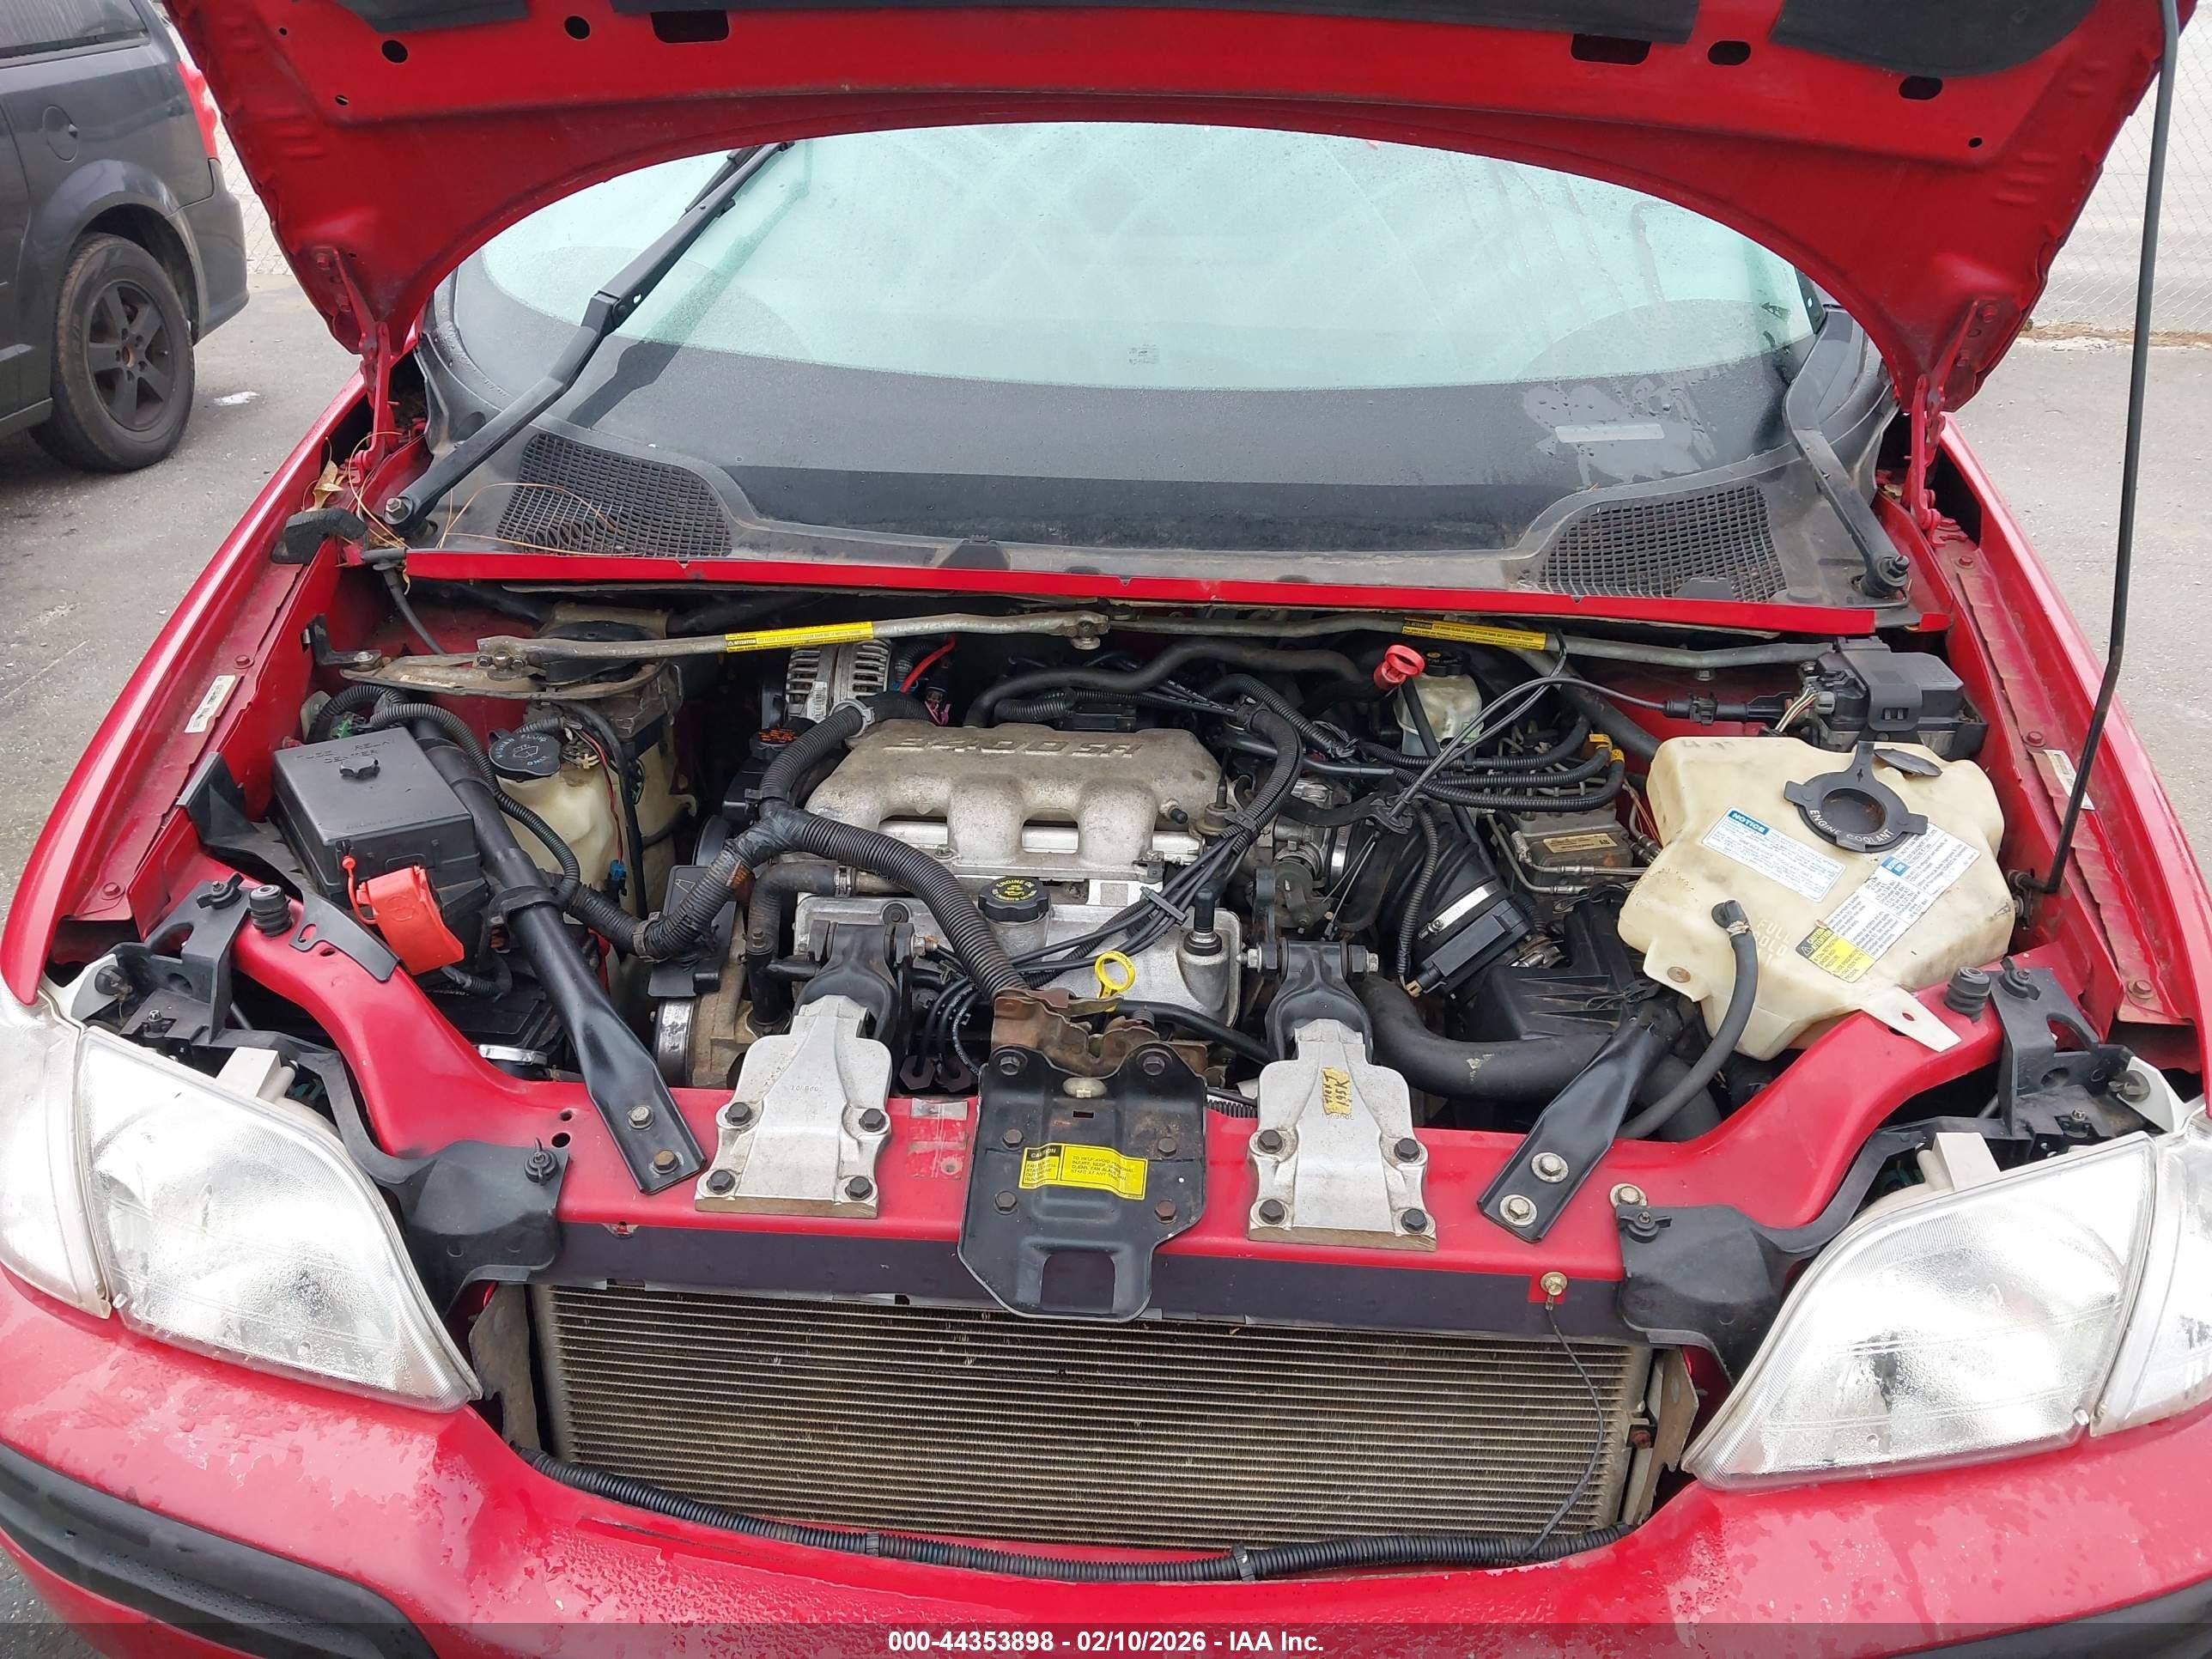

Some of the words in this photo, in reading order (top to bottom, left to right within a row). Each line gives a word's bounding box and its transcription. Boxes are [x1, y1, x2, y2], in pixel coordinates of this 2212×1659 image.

[1731, 812, 1766, 833] NOTICE
[1809, 810, 1842, 836] ENGINE
[1845, 829, 1894, 844] COOLANT
[1030, 1147, 1056, 1158] CAUTION
